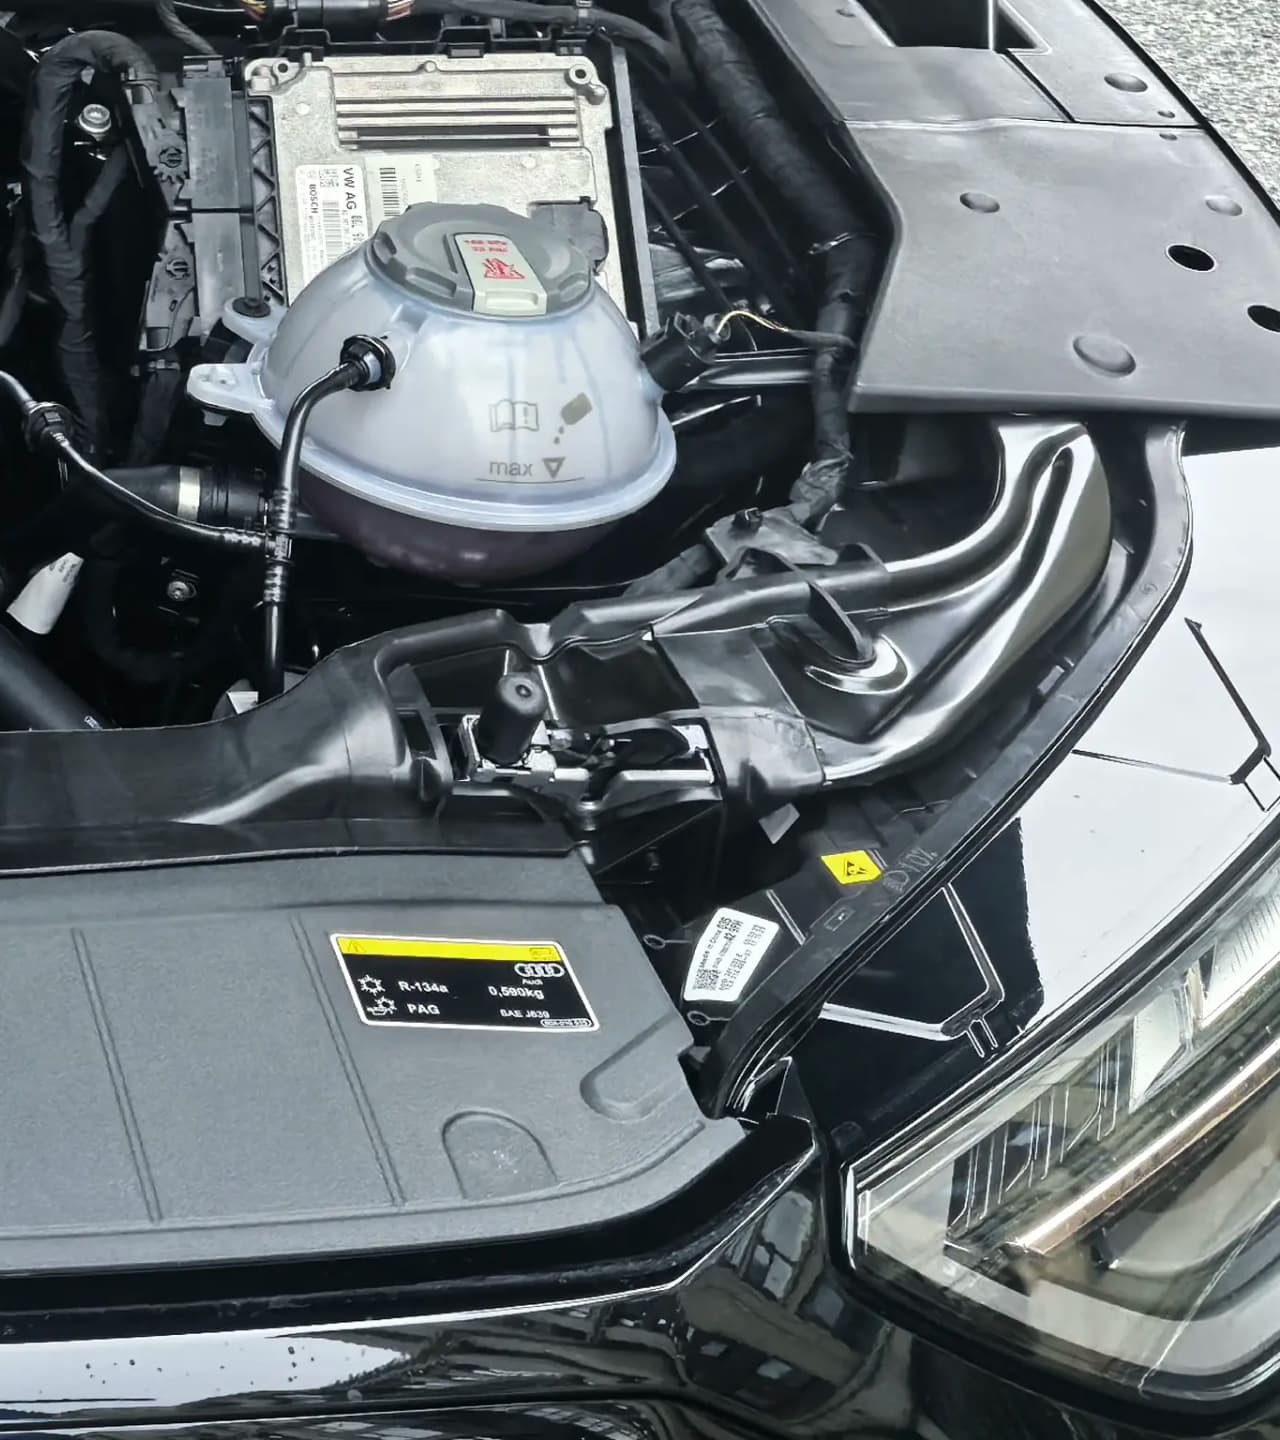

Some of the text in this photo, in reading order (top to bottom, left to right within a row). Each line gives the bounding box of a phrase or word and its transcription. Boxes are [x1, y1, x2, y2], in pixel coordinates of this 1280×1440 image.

[343, 167, 355, 188] VW
[309, 184, 319, 214] BOSCH
[346, 192, 357, 210] AG
[489, 461, 533, 477] max
[398, 981, 449, 993] R-134a
[406, 1003, 440, 1015] PAG
